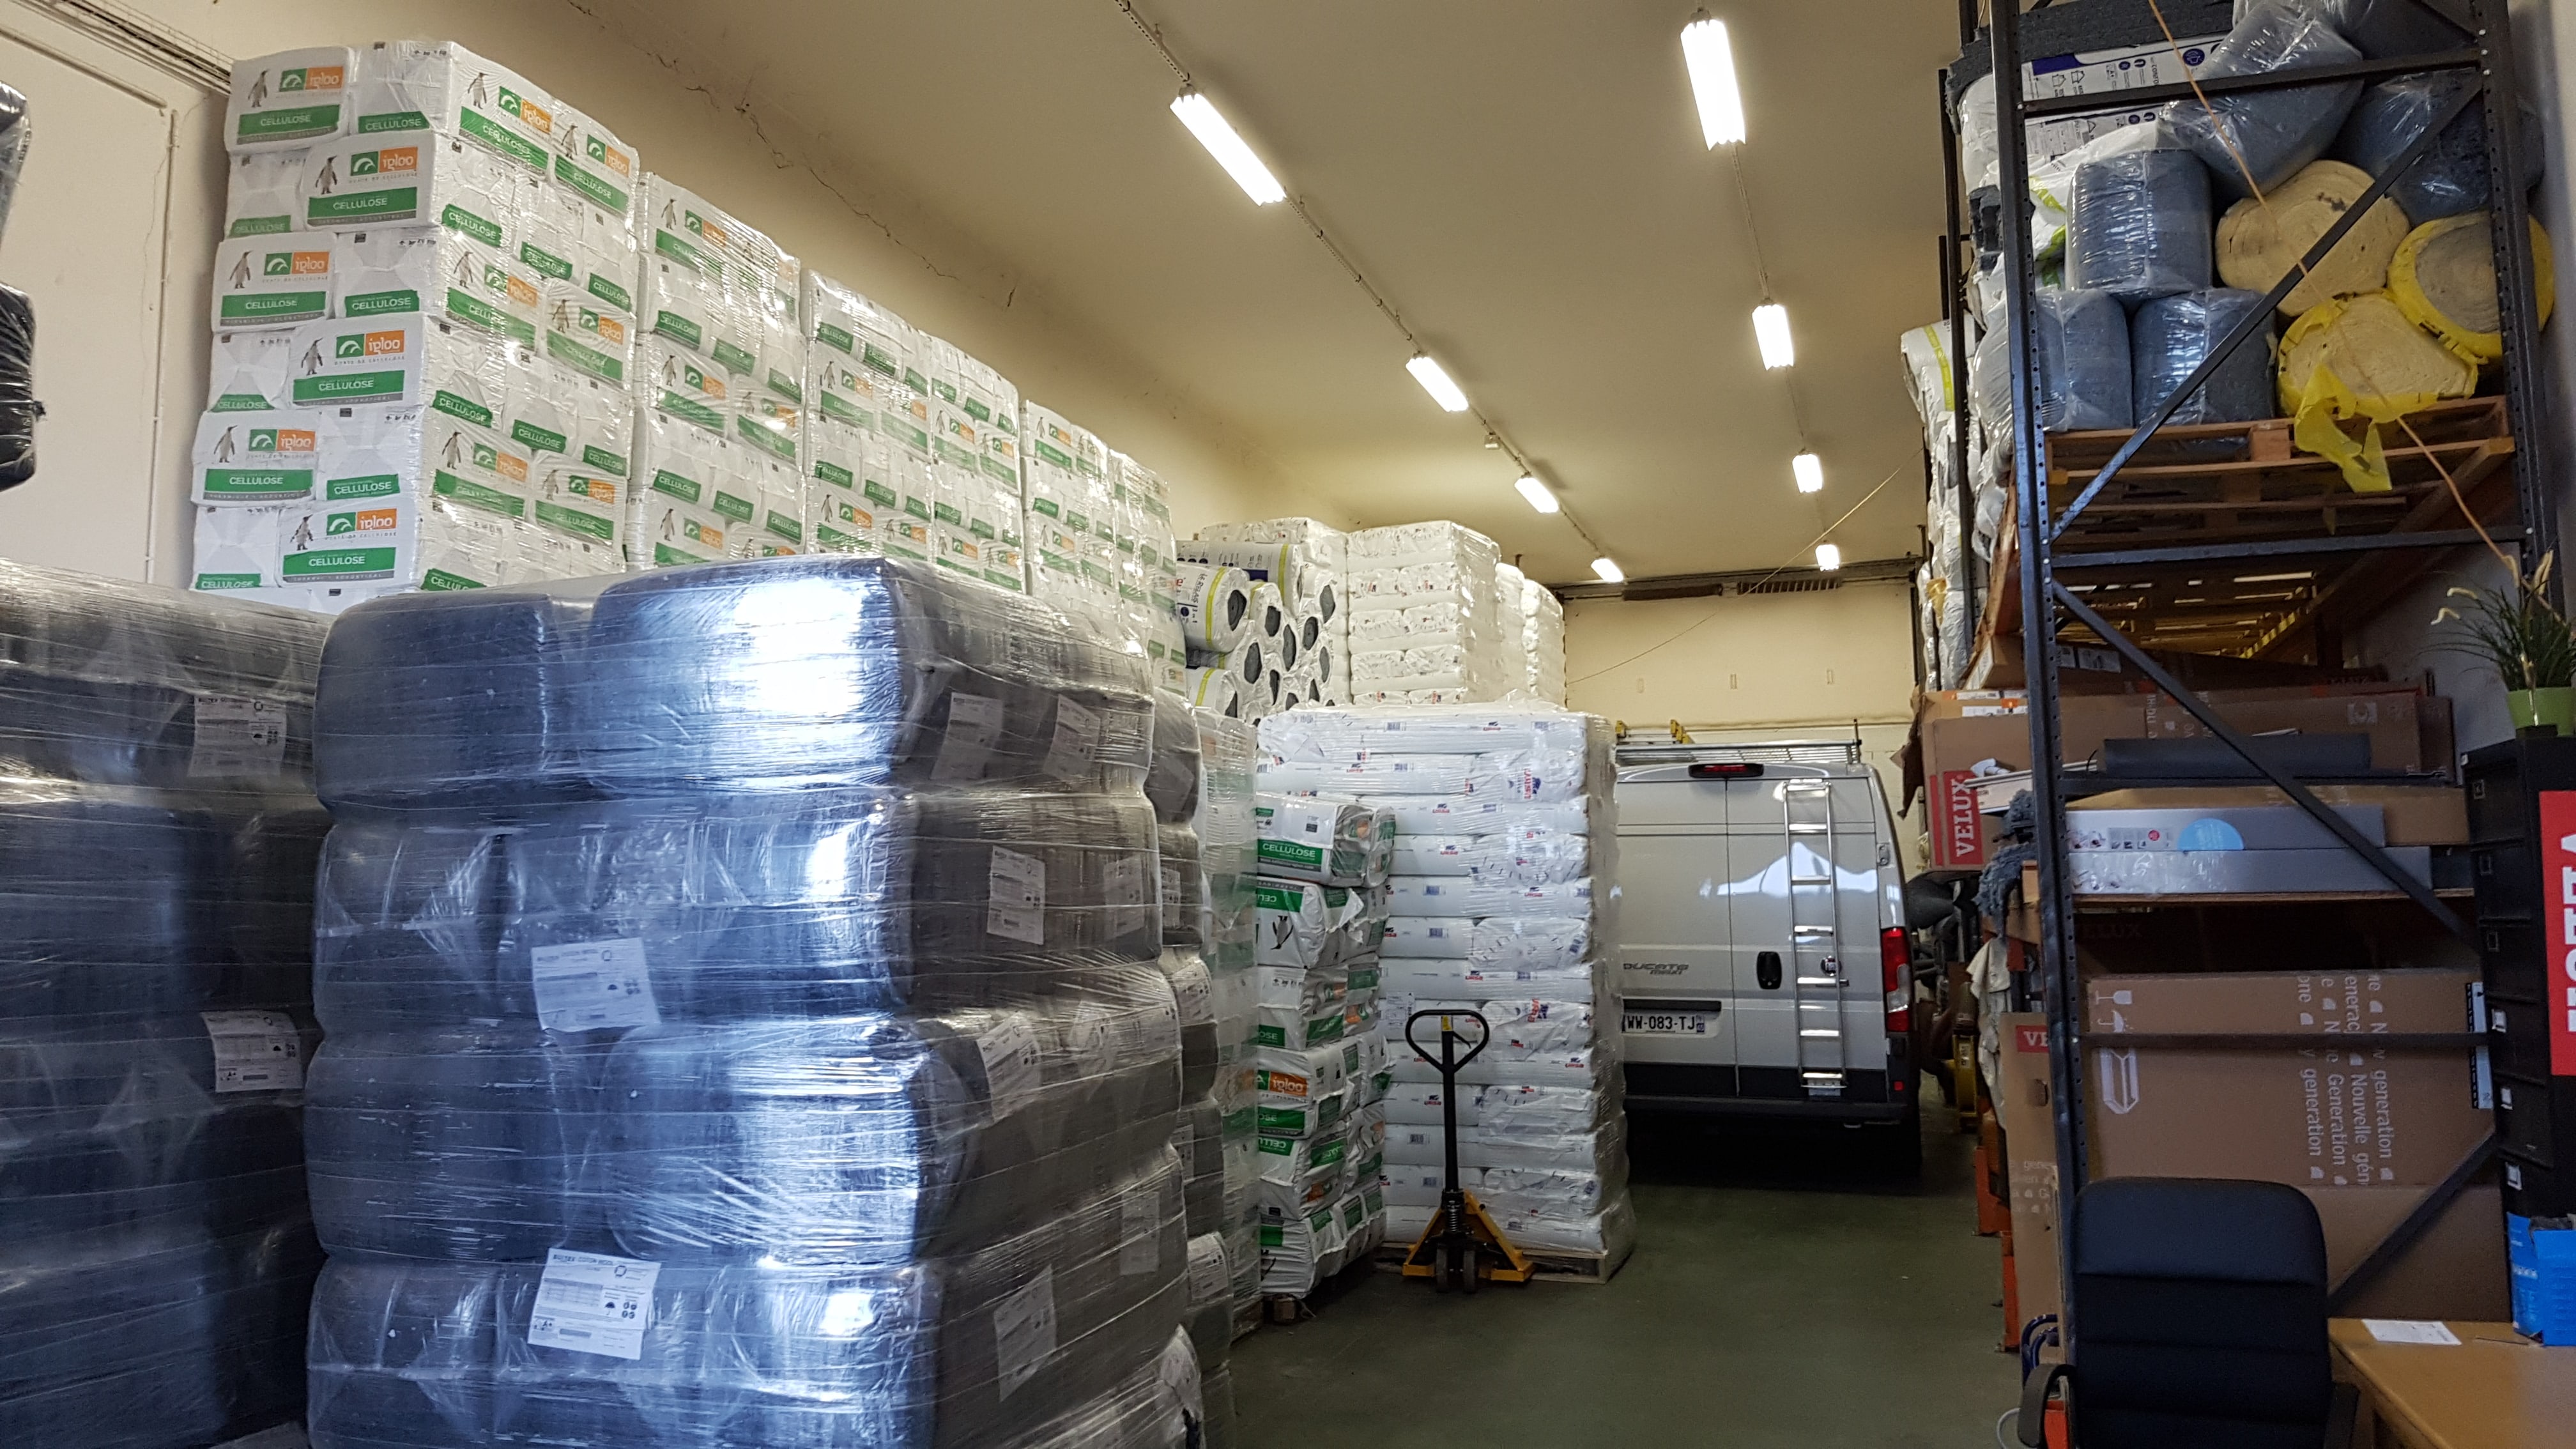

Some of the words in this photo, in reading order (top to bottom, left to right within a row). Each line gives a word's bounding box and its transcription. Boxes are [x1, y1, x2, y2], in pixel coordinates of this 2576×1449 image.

[309, 73, 340, 87] igloo
[260, 114, 311, 126] CELLULOSE
[365, 118, 422, 132] CELLULOSE
[383, 153, 414, 171] igloo
[333, 197, 388, 210] CELLULOSE
[448, 211, 497, 240] CELLULOSE
[295, 256, 325, 274] igloo
[594, 281, 631, 305] CELLULOSE
[245, 299, 298, 310] CELLULOSE
[352, 297, 412, 310] CELLULOSE
[368, 337, 401, 355] igloo
[319, 379, 374, 391] CELLULOSE
[217, 401, 268, 410] CELLULOSE
[440, 397, 487, 422] CELLULOSE
[281, 434, 312, 451] igloo
[518, 429, 562, 449] CELLULOSE
[229, 477, 283, 485] CELLULOSE
[334, 481, 393, 496] CELLULOSE
[659, 476, 696, 495] CELLULOSE
[360, 516, 392, 530] igloo
[309, 556, 365, 567] CELLULOSE
[201, 579, 254, 589] CELLULOSE
[431, 576, 470, 590] CELLULO
[1951, 779, 1975, 857] VELUX
[1262, 843, 1316, 857] CELLULOSE
[2345, 976, 2361, 1034] eneracj
[1627, 1016, 1695, 1031] WW-083-TJ
[1272, 1076, 1304, 1093] igloo
[2301, 1068, 2324, 1156] generation
[2350, 1073, 2372, 1144] Nouvelle
[2374, 1070, 2395, 1158] generation
[2327, 1074, 2348, 1165] Generation
[2352, 1153, 2374, 1185] gén
